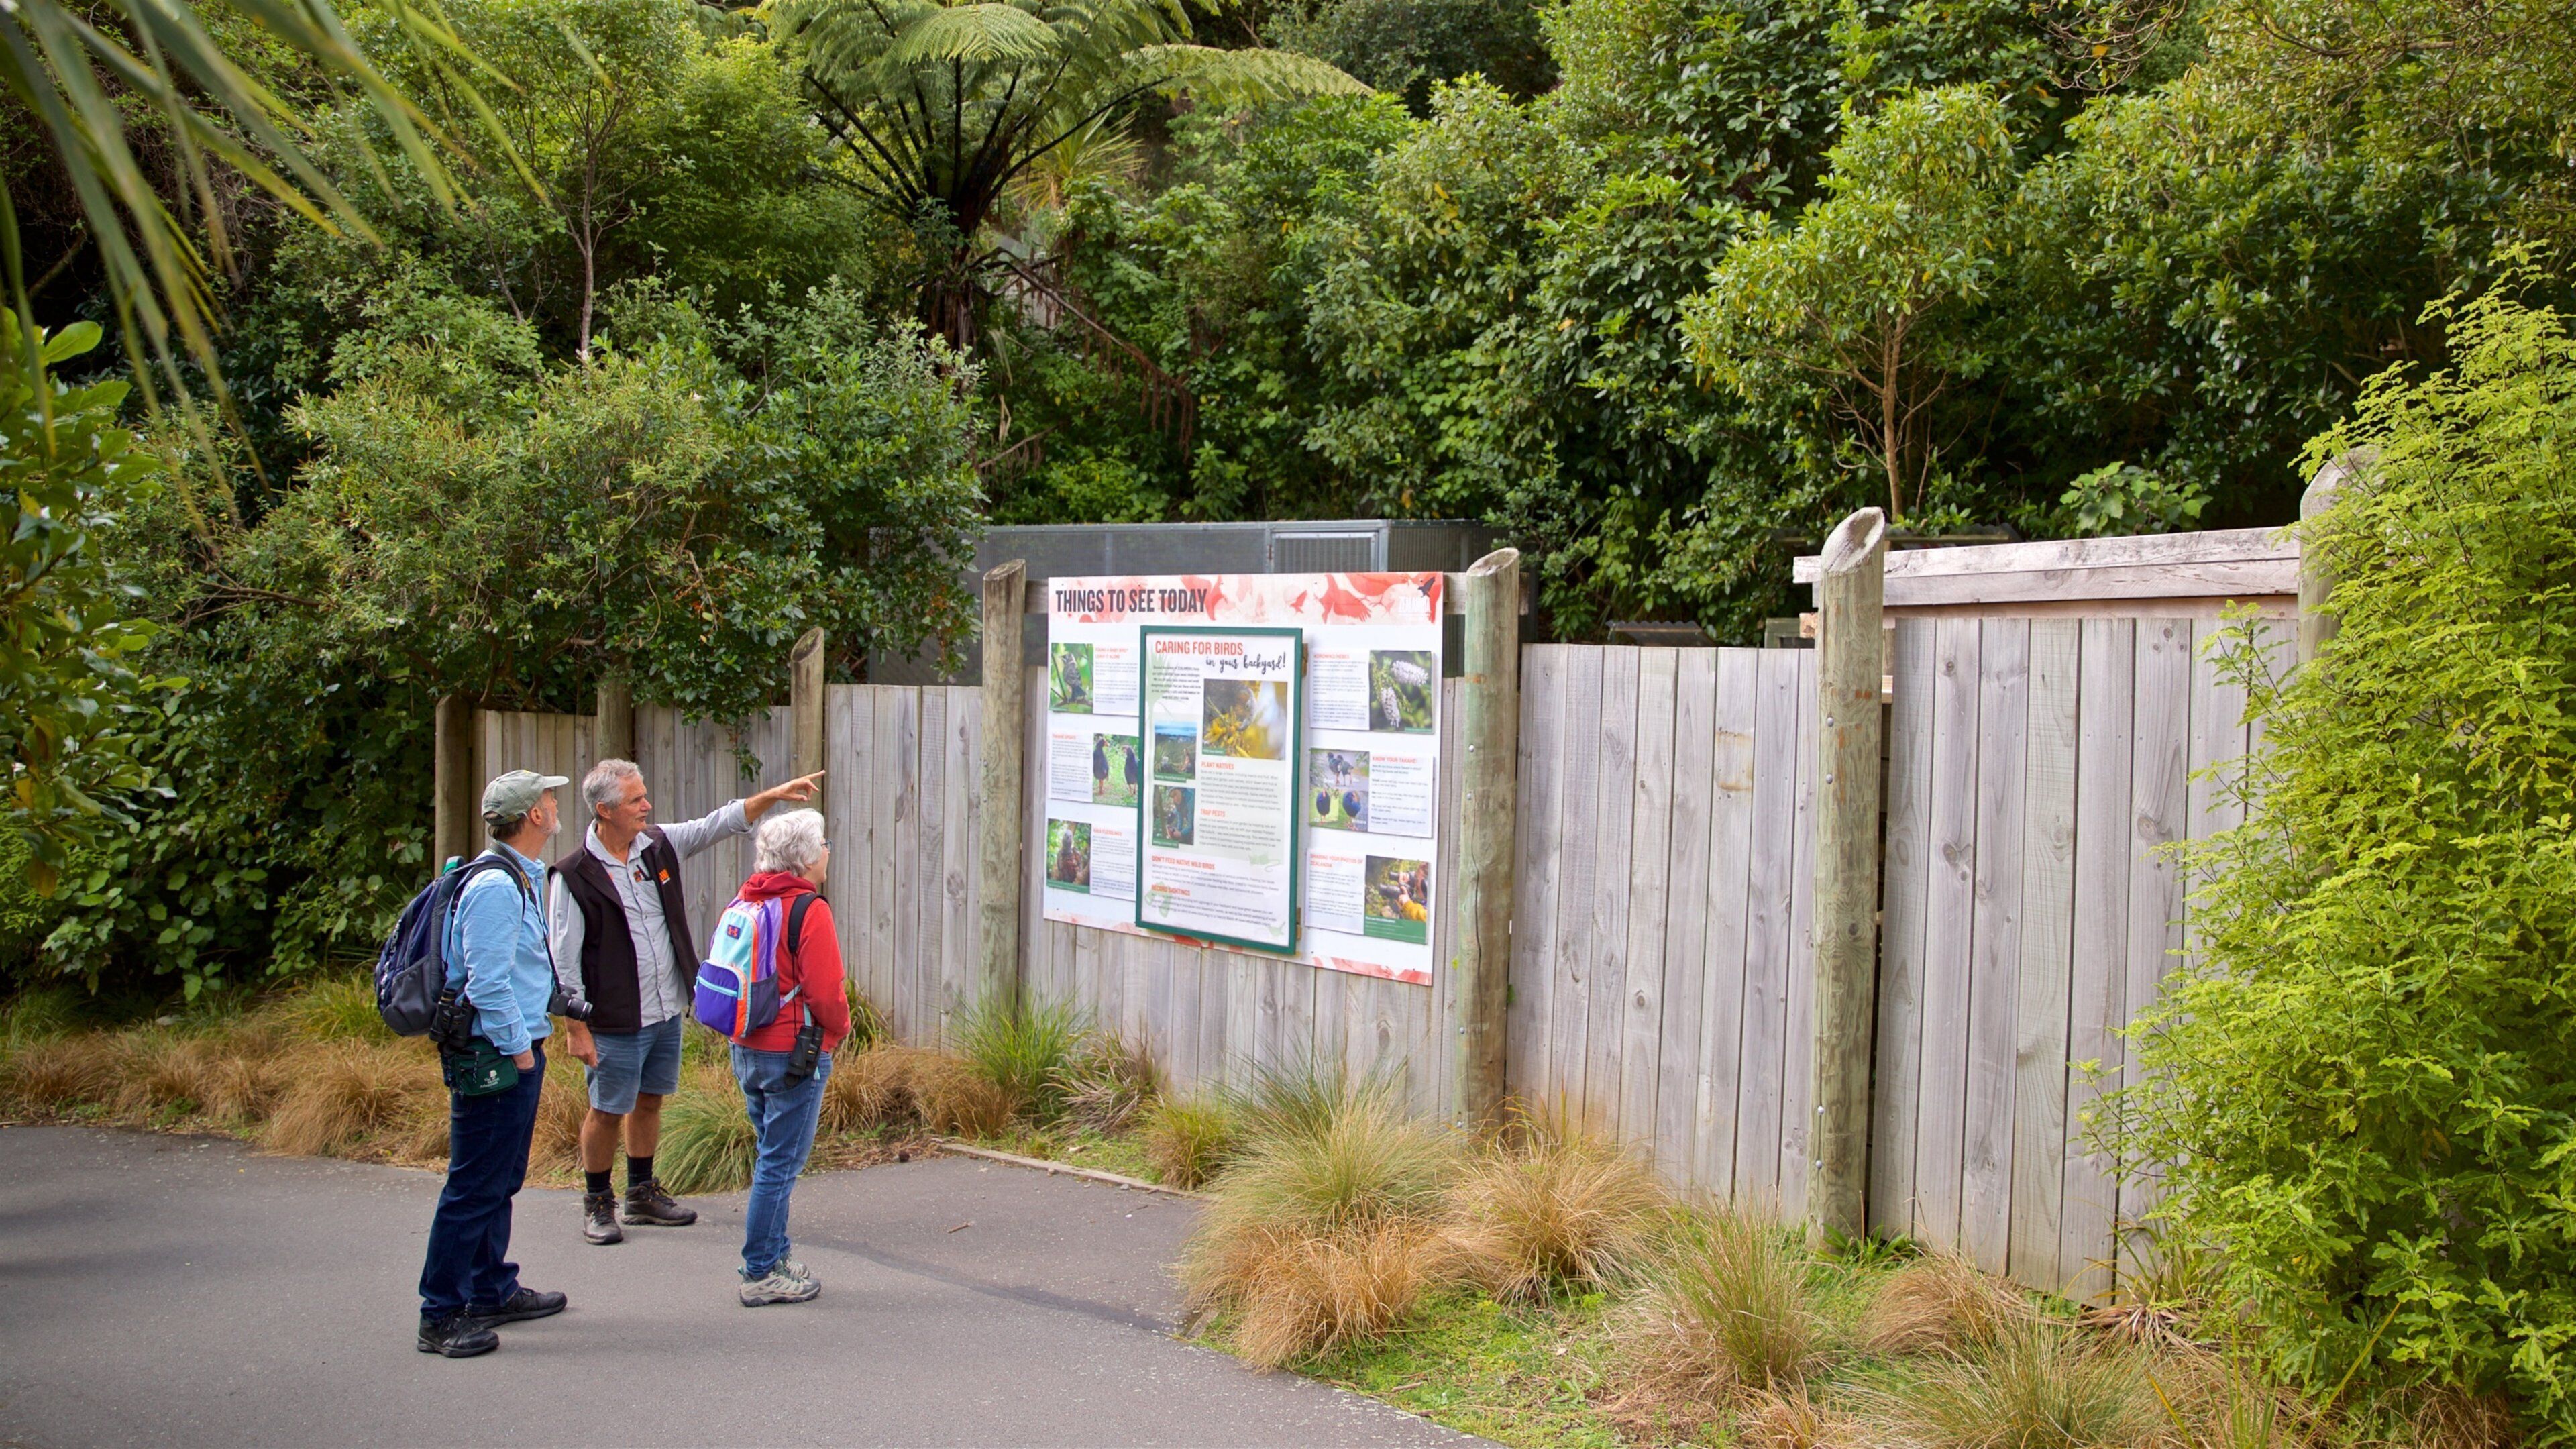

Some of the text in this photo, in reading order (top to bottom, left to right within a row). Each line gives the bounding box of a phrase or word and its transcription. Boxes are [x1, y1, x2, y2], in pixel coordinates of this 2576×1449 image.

[1055, 588, 1208, 613] THINGS TO SEE TODAY
[1155, 640, 1243, 655] CARING FOR BIRDS
[1205, 651, 1286, 674] in your backyard!
